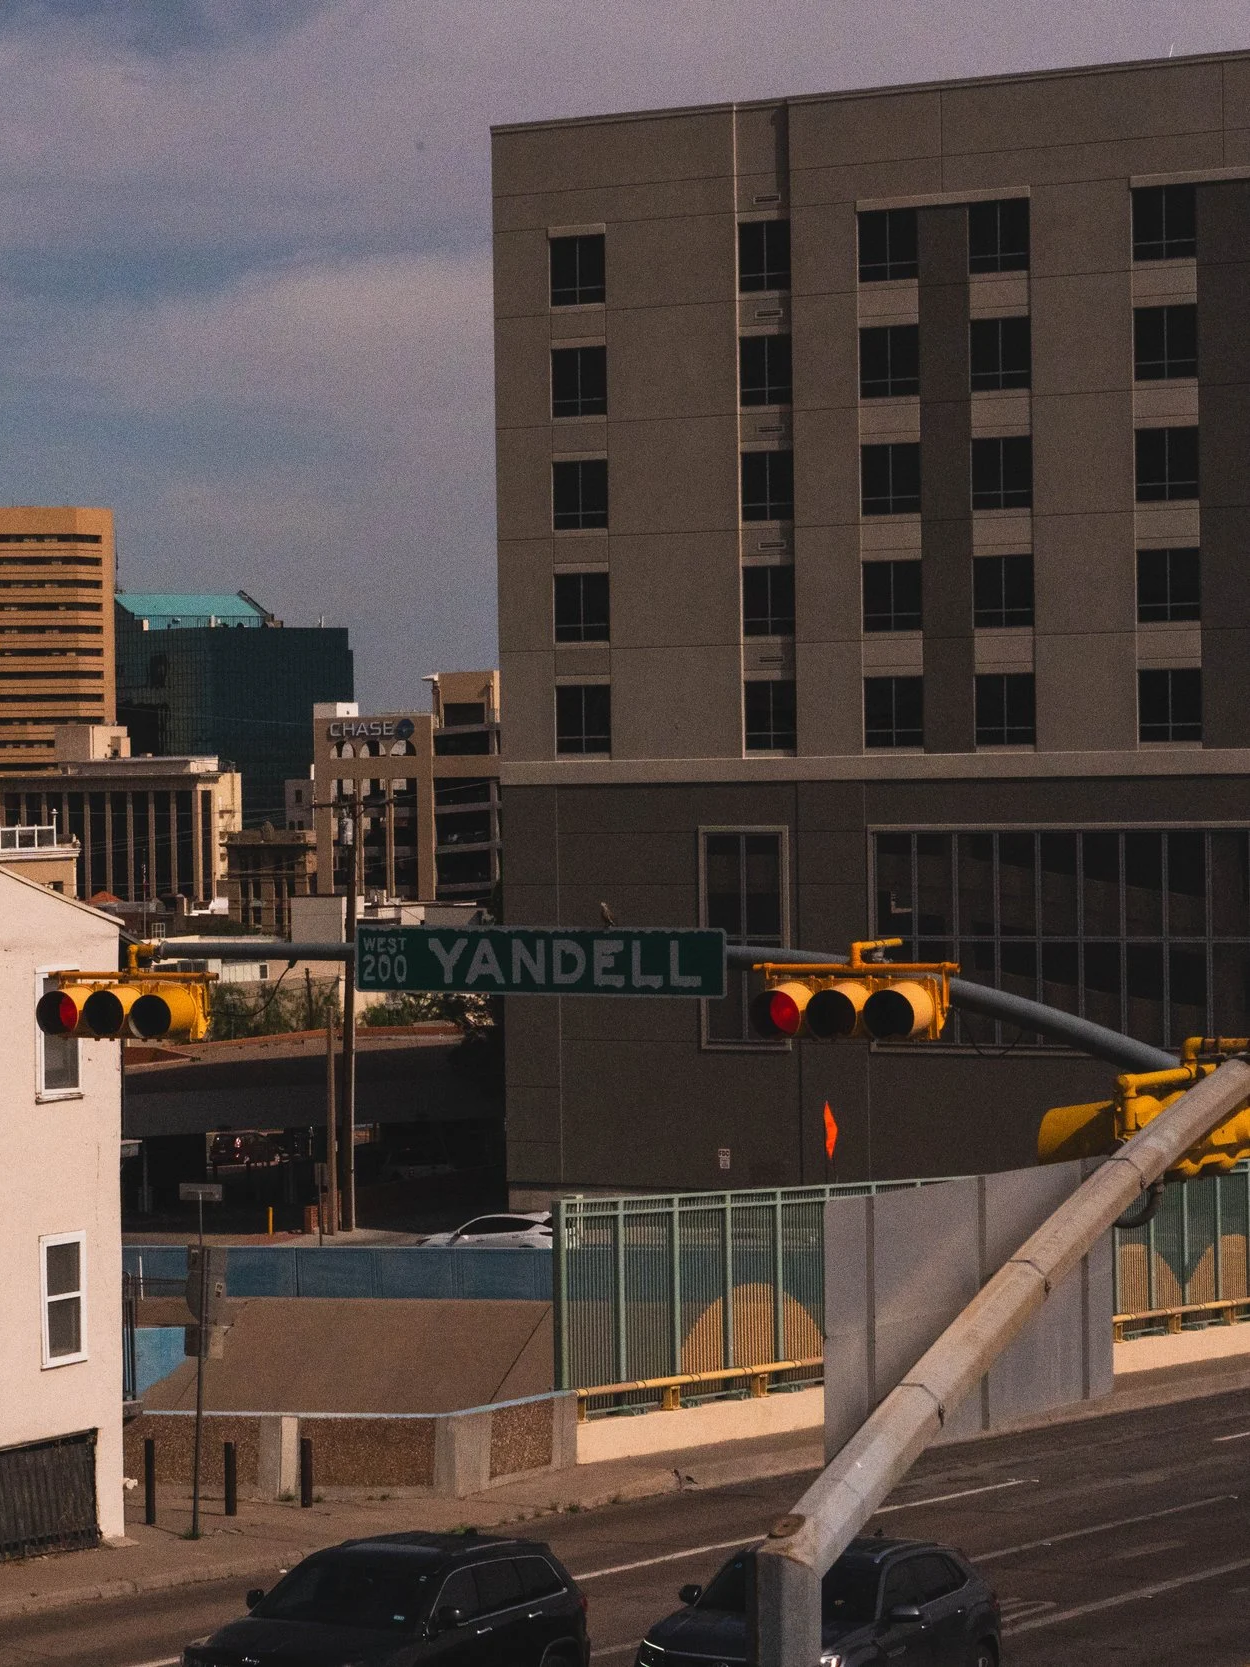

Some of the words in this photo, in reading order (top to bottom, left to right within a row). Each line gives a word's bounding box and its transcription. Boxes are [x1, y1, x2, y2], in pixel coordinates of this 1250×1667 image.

[329, 720, 395, 738] CHASE
[362, 936, 408, 955] WEST
[362, 954, 408, 983] 200
[427, 937, 702, 989] YANDELL
